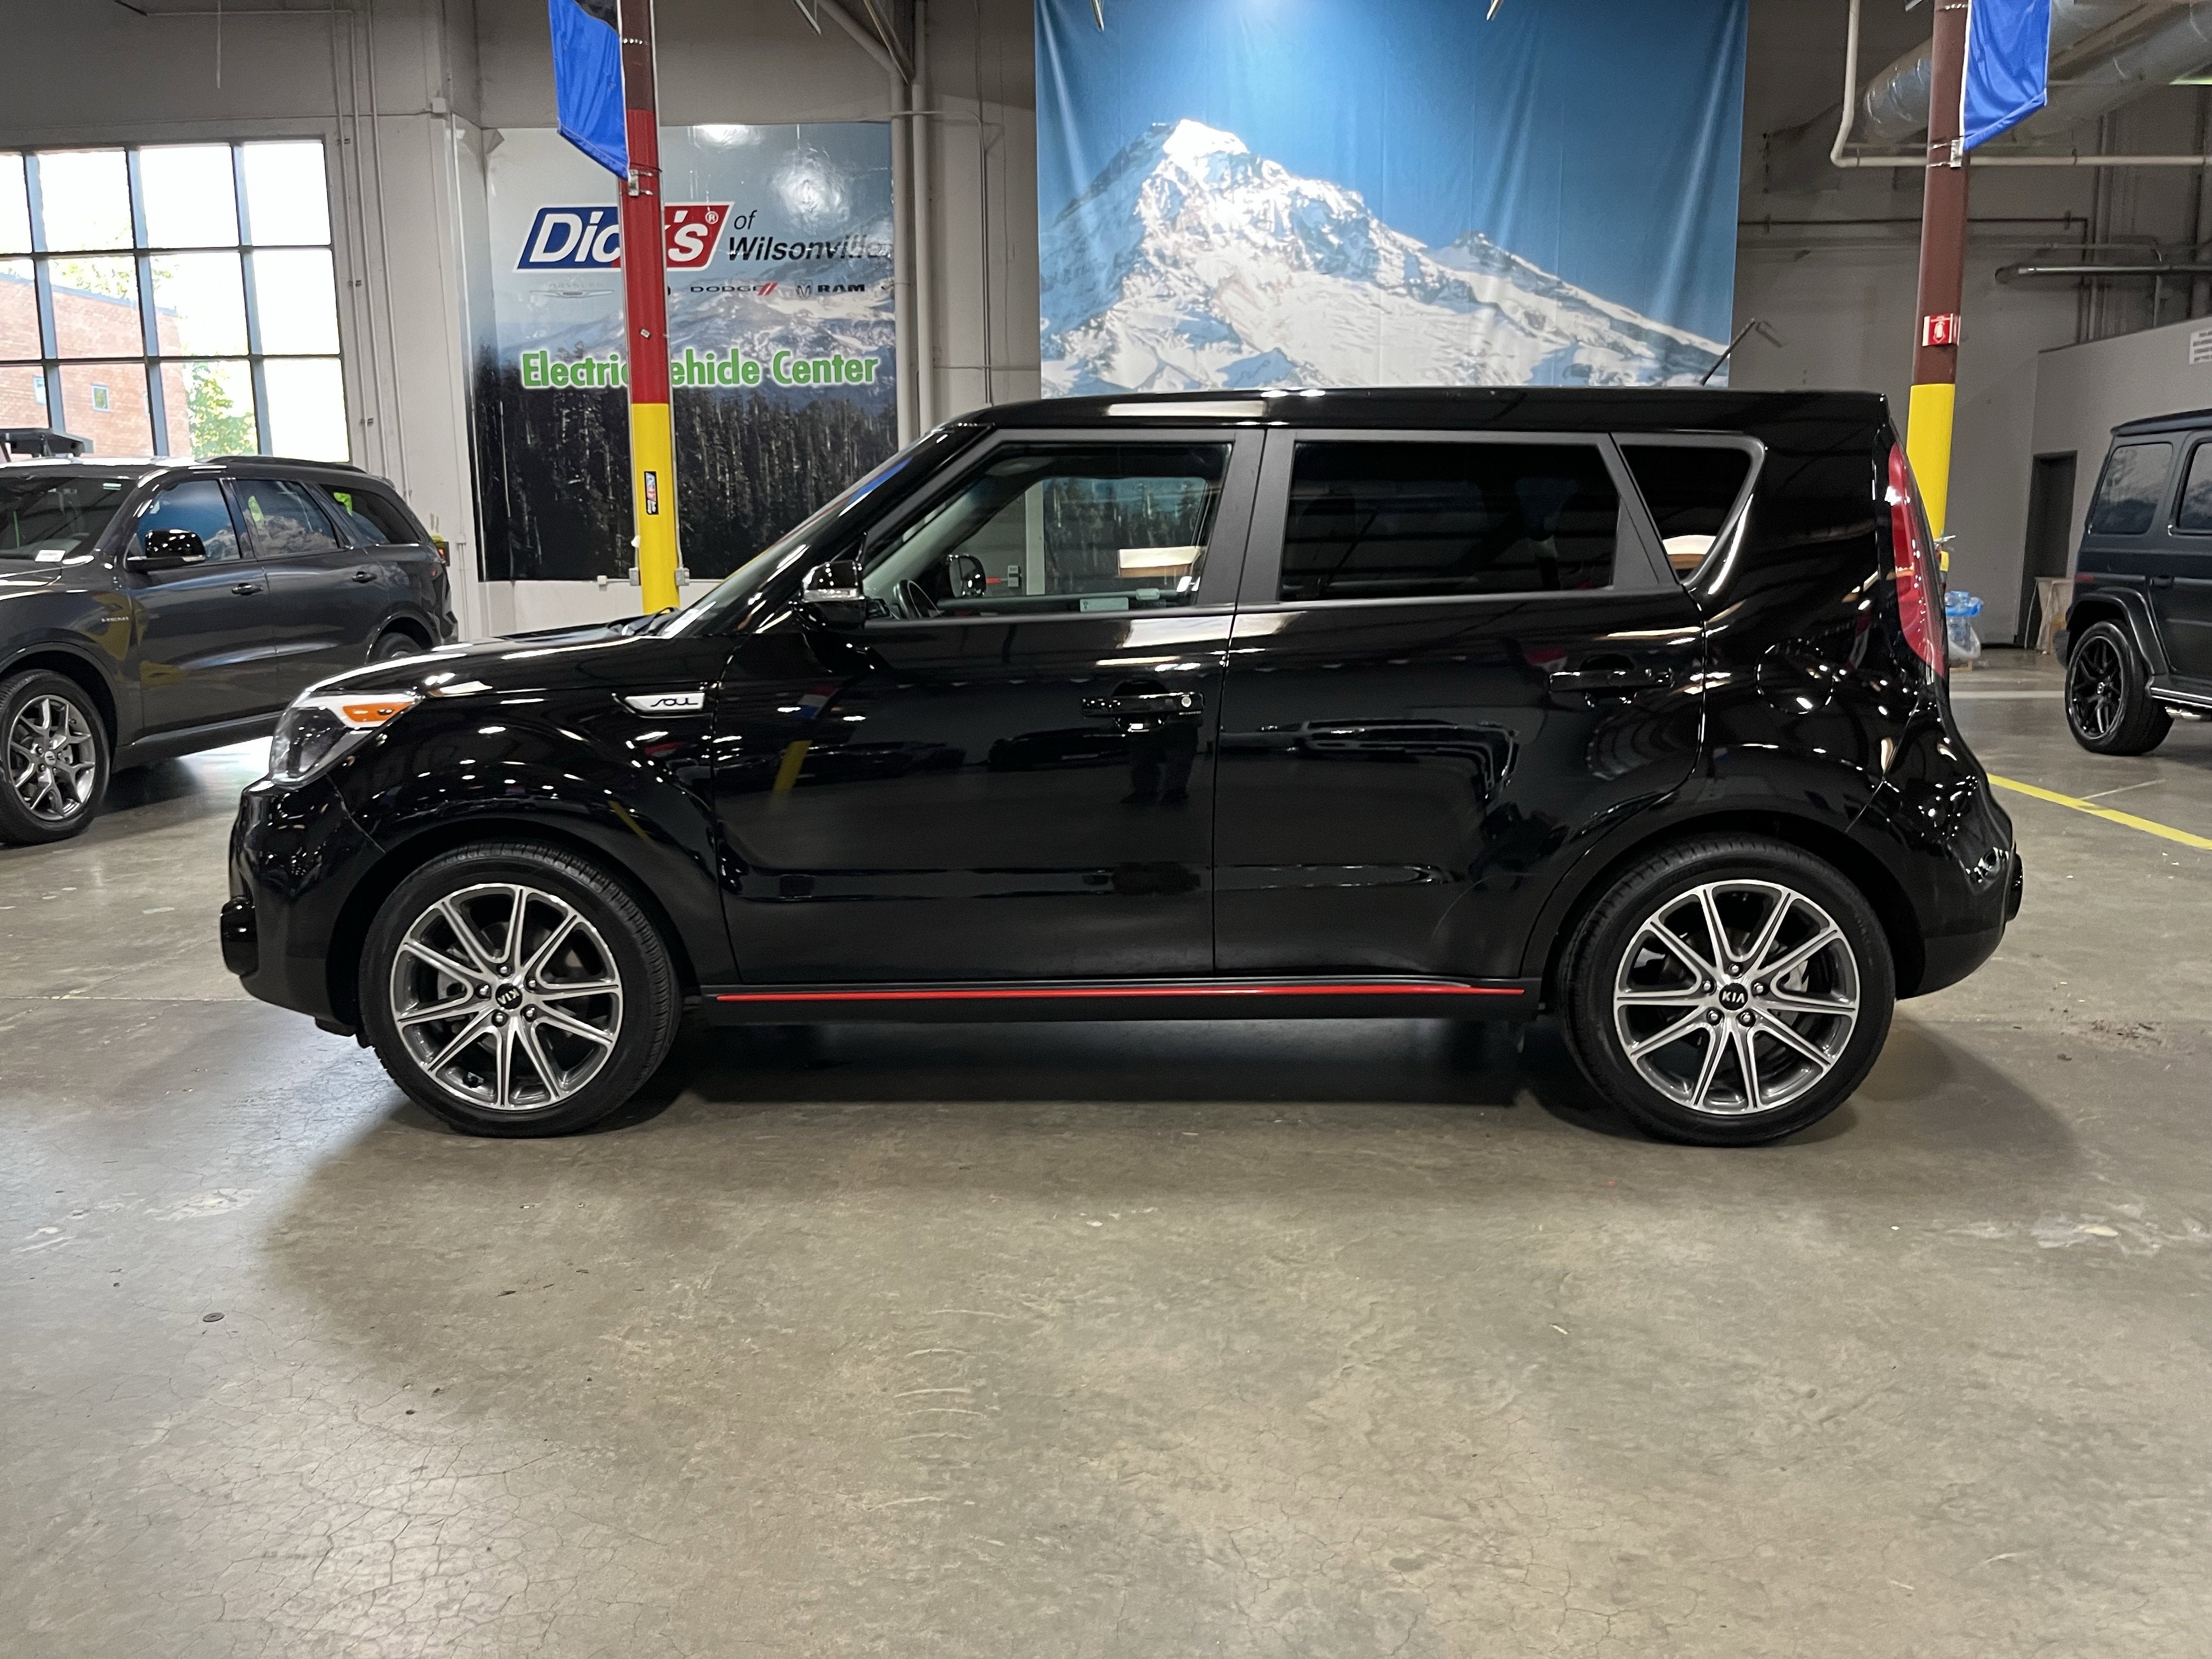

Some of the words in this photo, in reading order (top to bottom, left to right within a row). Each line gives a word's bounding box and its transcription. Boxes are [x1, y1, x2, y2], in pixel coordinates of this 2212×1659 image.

[733, 210, 758, 229] of
[529, 210, 708, 263] Dic's
[817, 284, 865, 293] RAM
[671, 348, 760, 385] ehicle
[773, 350, 878, 384] Center
[1722, 990, 1745, 1003] KIA
